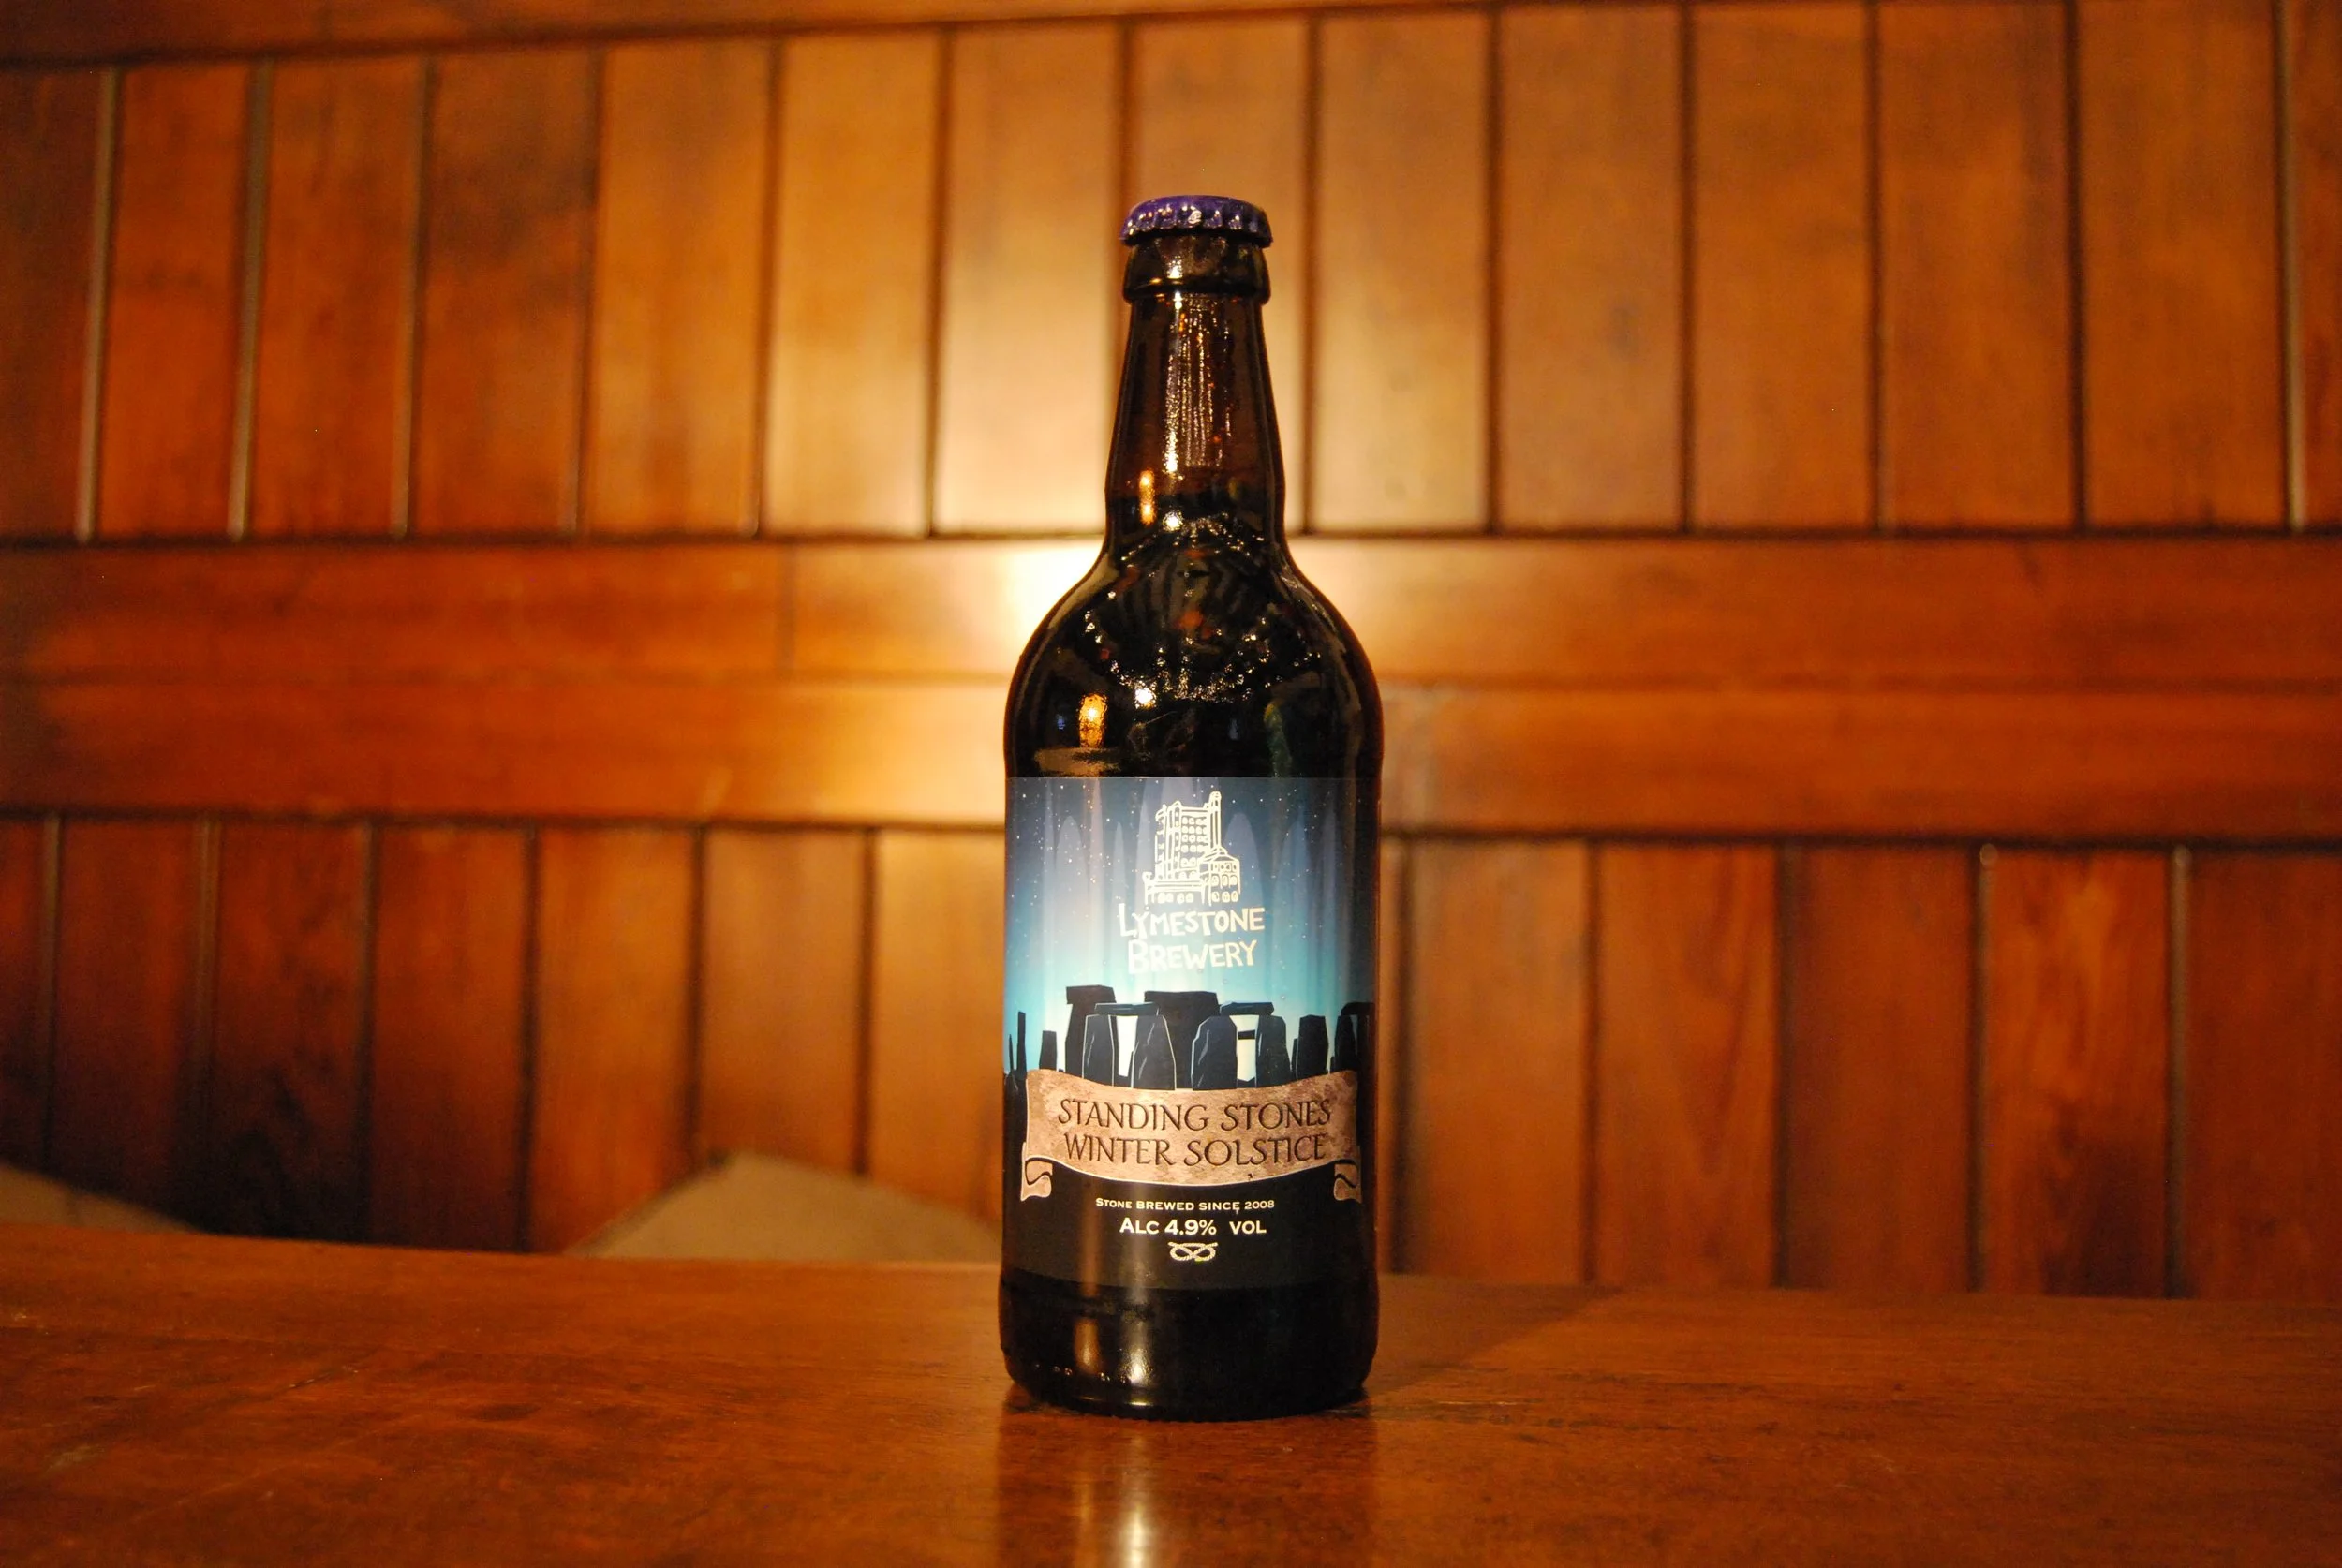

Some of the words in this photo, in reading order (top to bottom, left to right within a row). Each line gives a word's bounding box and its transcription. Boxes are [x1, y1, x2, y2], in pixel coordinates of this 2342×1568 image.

[1119, 903, 1265, 939] LYMESTONE
[1128, 939, 1257, 974] BREWERY
[1058, 1099, 1209, 1131] STANDING
[1220, 1098, 1332, 1132] STONES
[1064, 1133, 1175, 1165] WINTER
[1183, 1133, 1327, 1166] SOLSTICE
[1095, 1197, 1134, 1209] STONE
[1135, 1199, 1195, 1211] BREWED
[1198, 1201, 1240, 1211] SINCE
[1244, 1199, 1275, 1210] 2008
[1119, 1218, 1159, 1235] ALC
[1164, 1219, 1217, 1235] 4.9%
[1229, 1220, 1267, 1235] VOL
